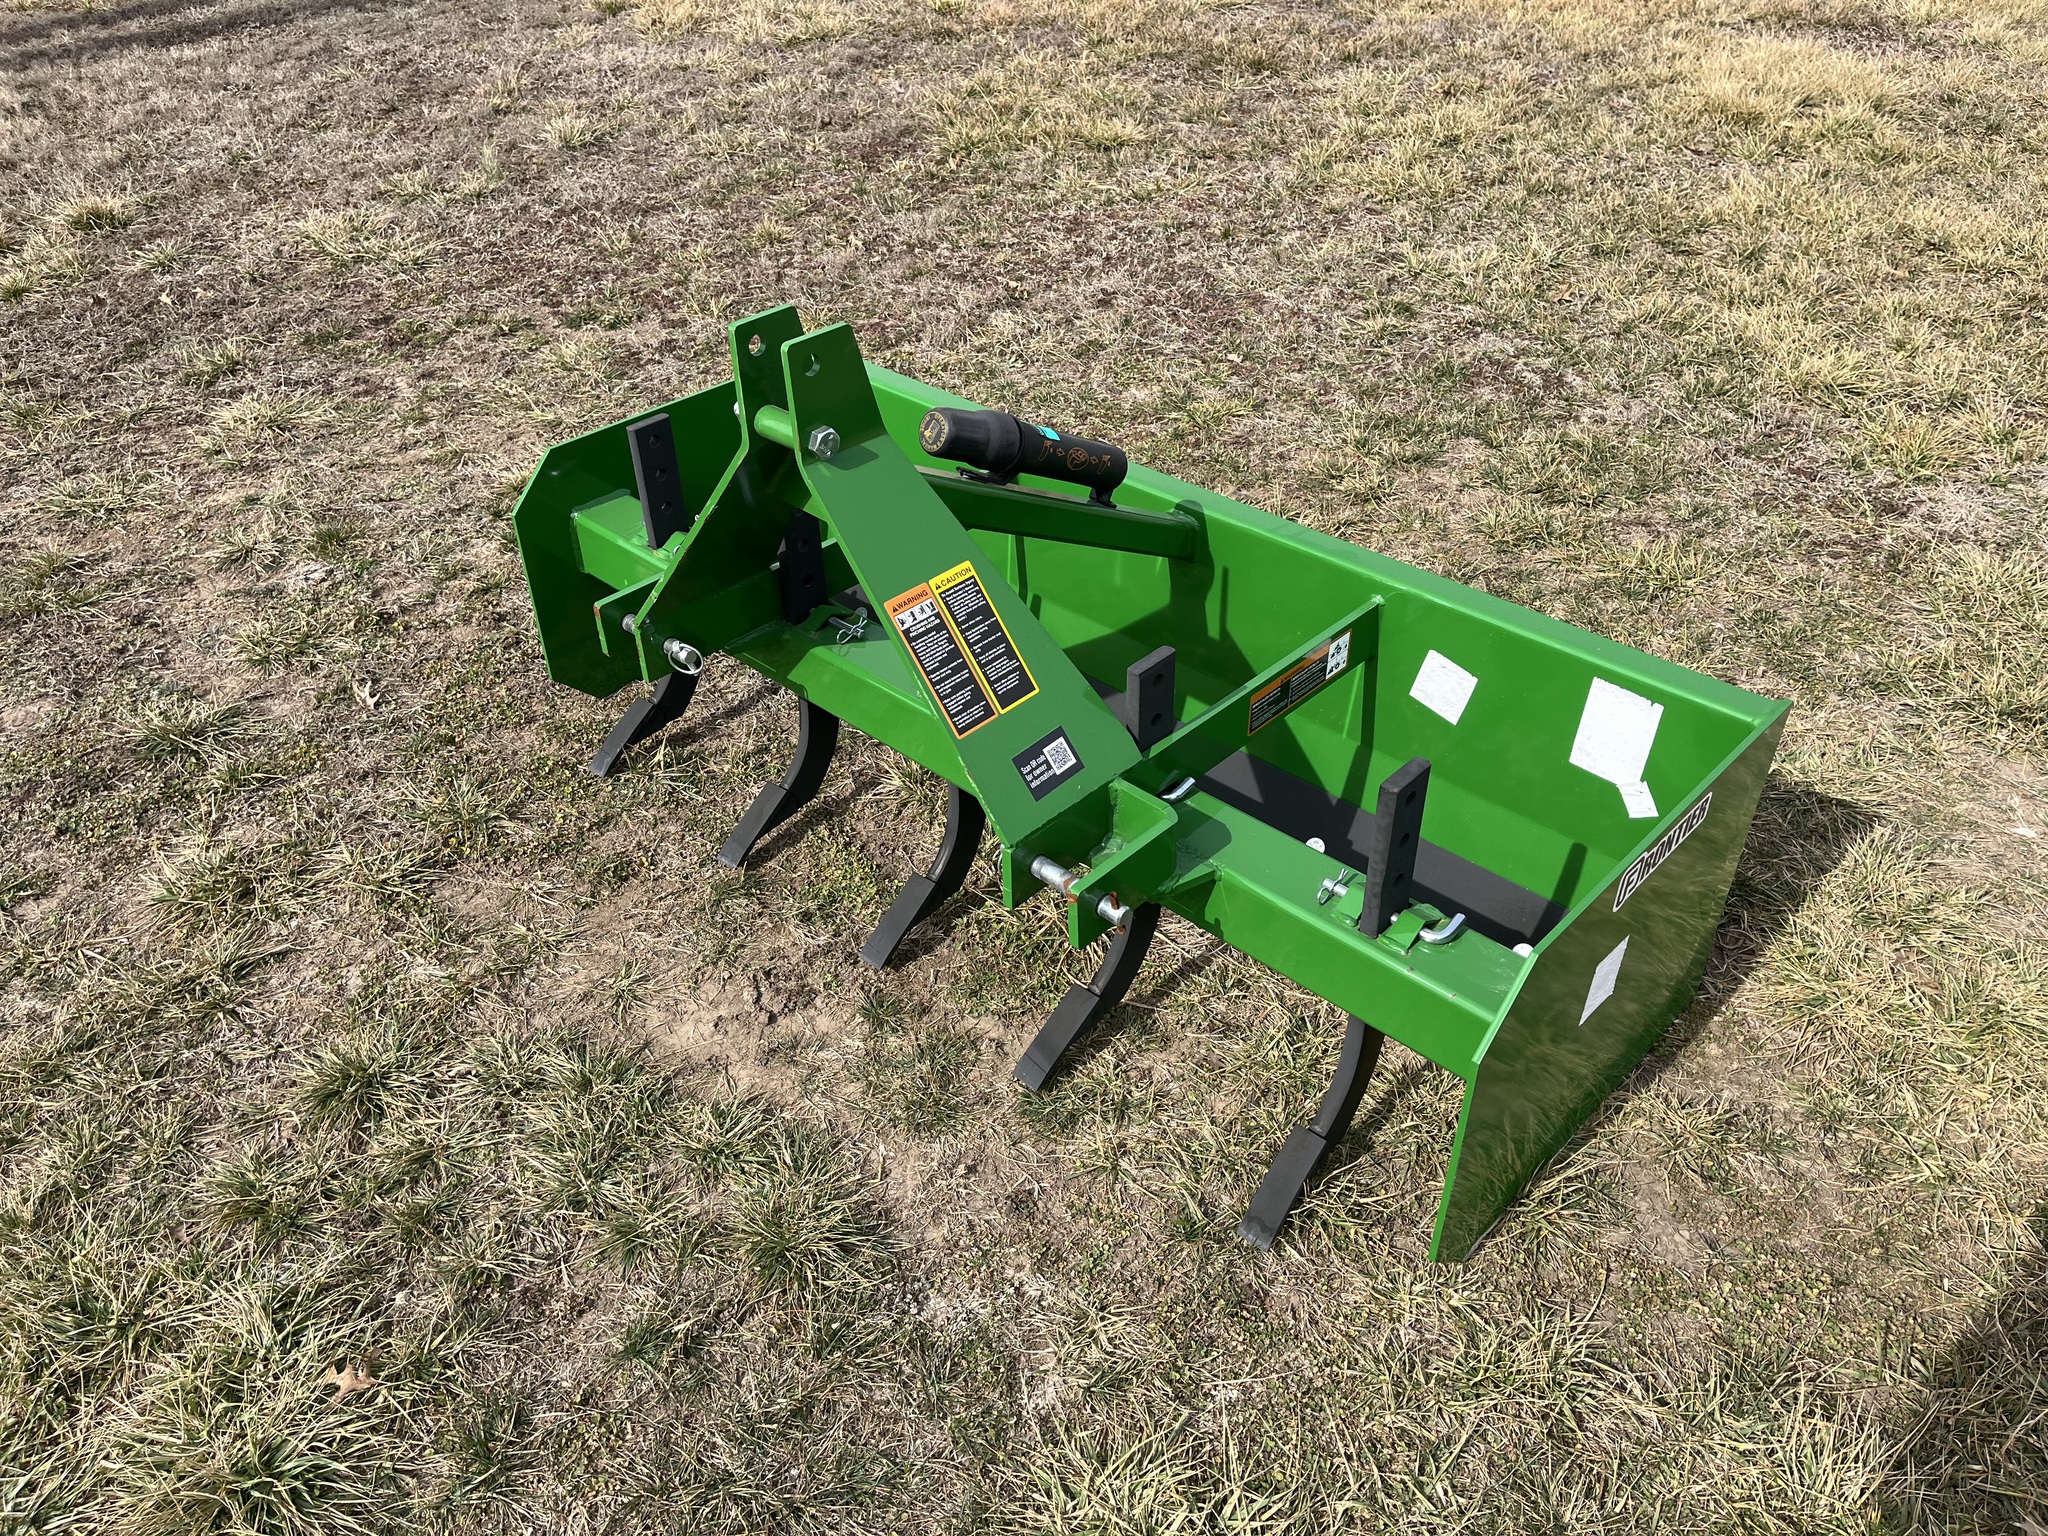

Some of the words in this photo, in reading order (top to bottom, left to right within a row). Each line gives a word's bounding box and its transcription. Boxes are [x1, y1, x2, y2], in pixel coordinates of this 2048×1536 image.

[940, 566, 972, 587] CAUTION
[896, 589, 929, 609] WARNING
[1020, 762, 1031, 774] Scan
[1029, 758, 1037, 768] QR
[1035, 753, 1046, 764] code
[1024, 771, 1033, 781] for
[1032, 762, 1048, 777] owner
[1029, 767, 1055, 789] information
[1614, 793, 1712, 910] FRONTIER
